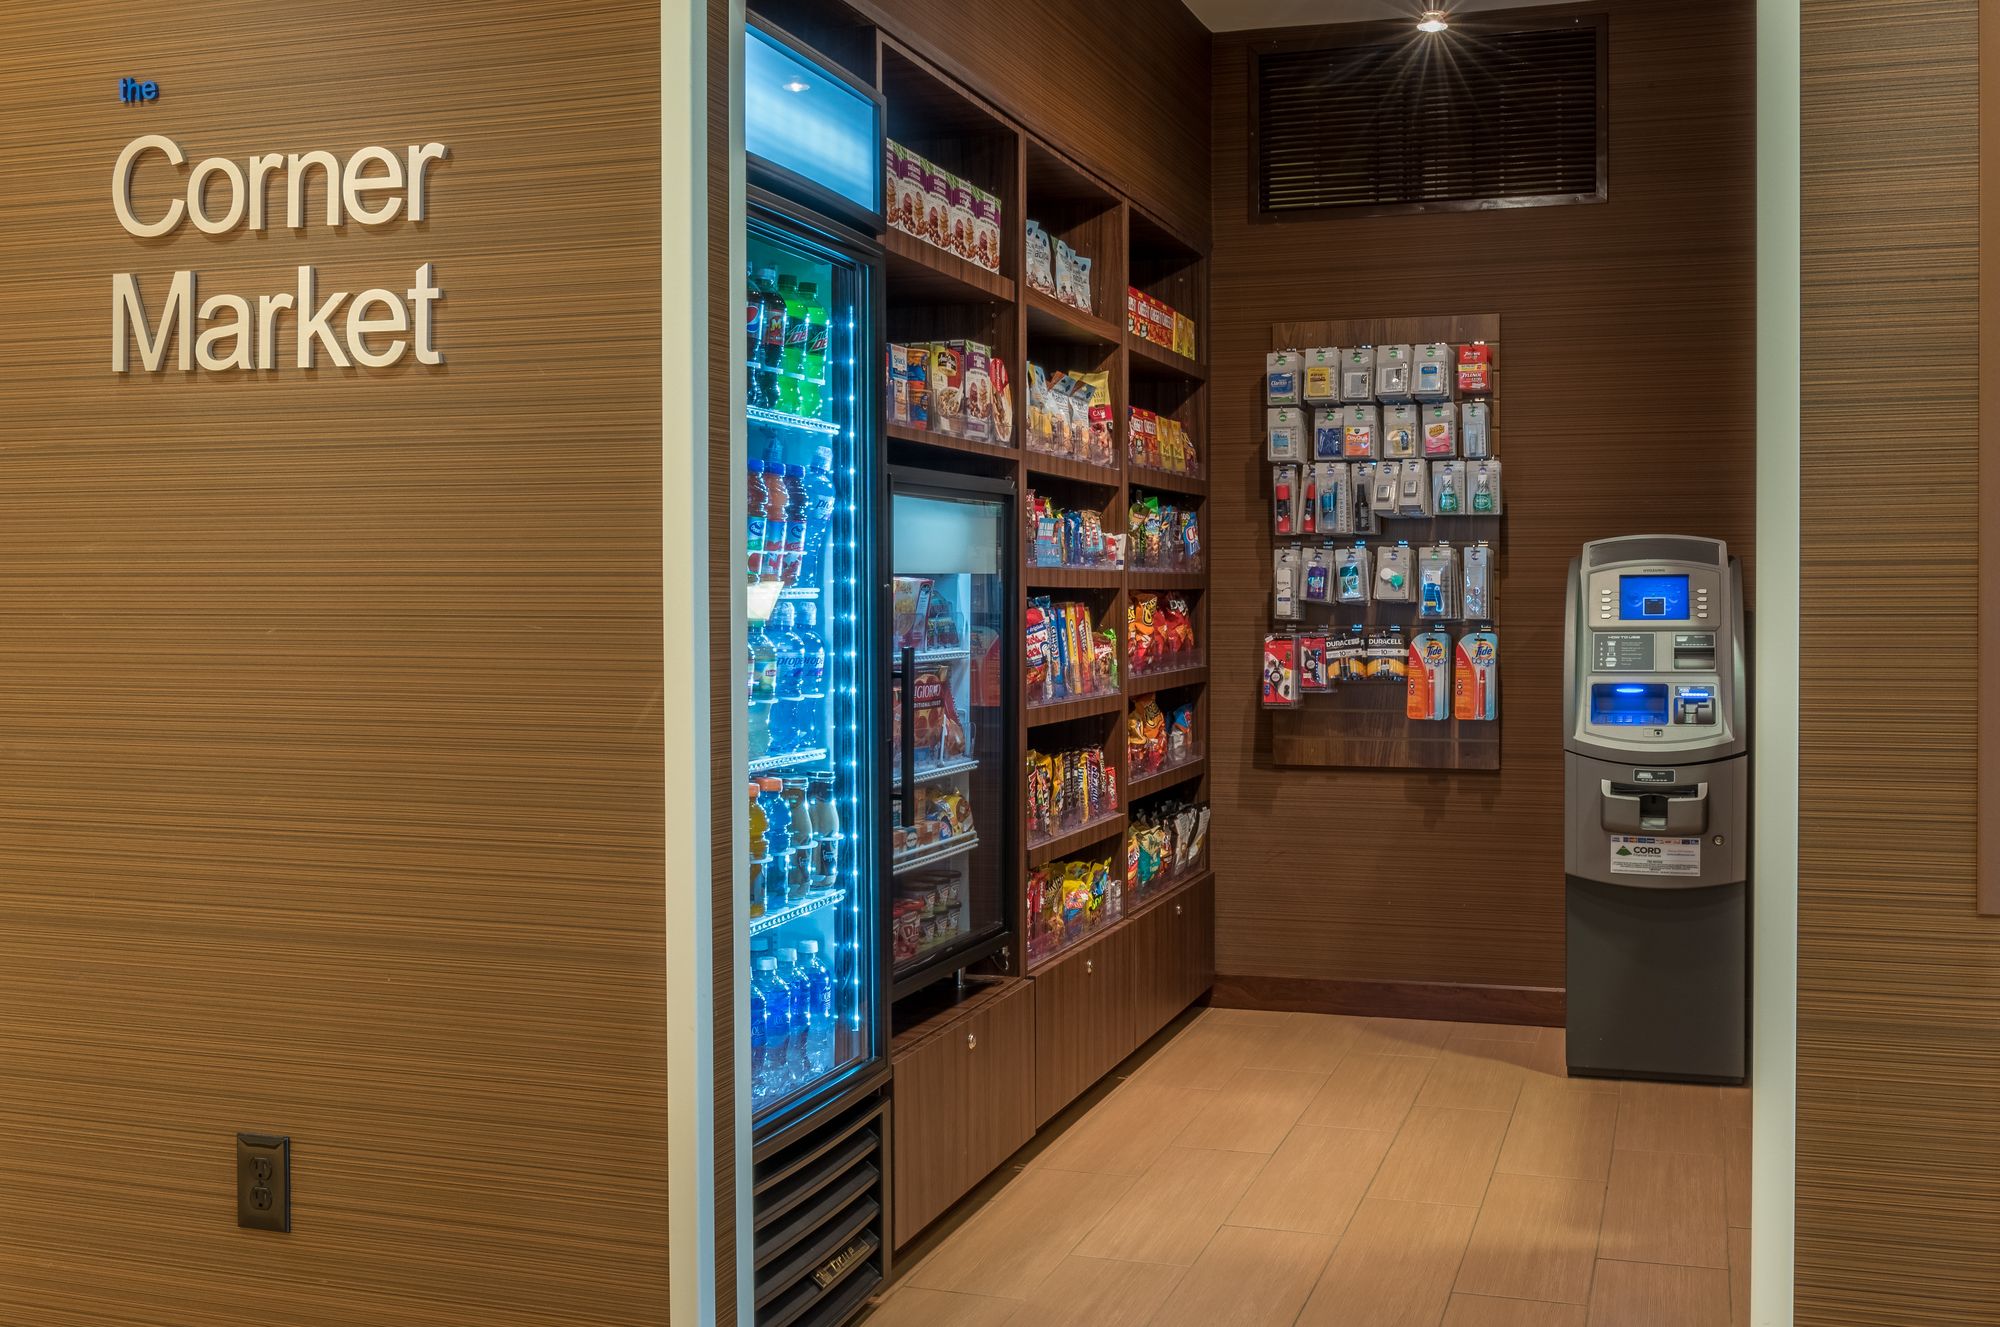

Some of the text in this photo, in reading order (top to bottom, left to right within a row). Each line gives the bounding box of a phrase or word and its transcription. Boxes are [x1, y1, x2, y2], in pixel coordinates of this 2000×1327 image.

[118, 77, 159, 103] the
[112, 133, 448, 238] Corner
[112, 262, 443, 372] Market
[1427, 646, 1442, 657] Tide
[1475, 646, 1493, 657] Tide
[1483, 658, 1495, 667] go
[914, 683, 941, 699] IGIORNO
[1633, 846, 1662, 855] CORD
